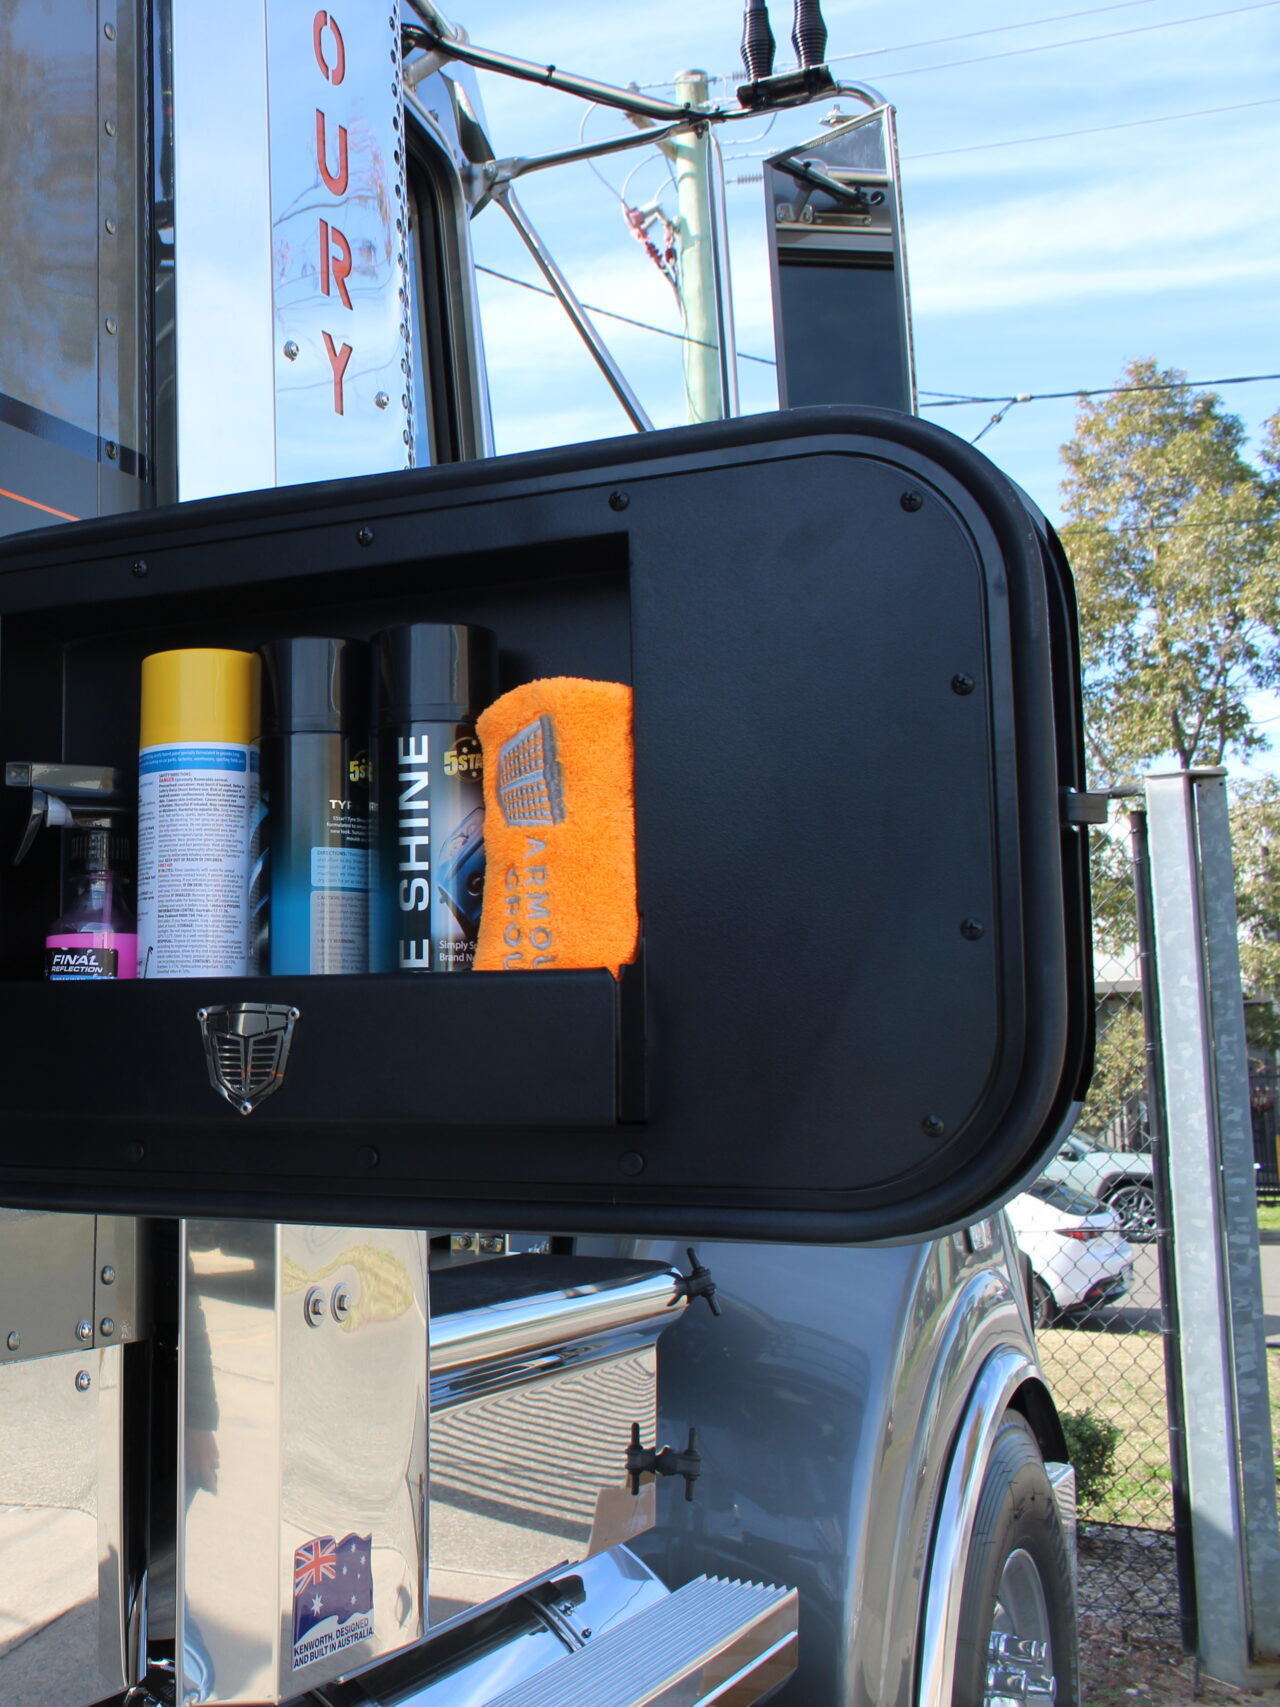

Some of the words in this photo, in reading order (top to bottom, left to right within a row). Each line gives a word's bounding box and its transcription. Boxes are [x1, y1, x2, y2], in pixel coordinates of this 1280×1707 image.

[444, 751, 482, 776] 5STA
[398, 735, 429, 912] SHINE
[398, 939, 429, 969] E
[439, 940, 468, 951] Simply
[52, 954, 99, 966] FINAL
[439, 953, 465, 962] Brand
[336, 1617, 369, 1639] DESIGNED
[294, 1654, 309, 1668] AND
[310, 1645, 328, 1662] BUILT
[329, 1641, 337, 1653] IN
